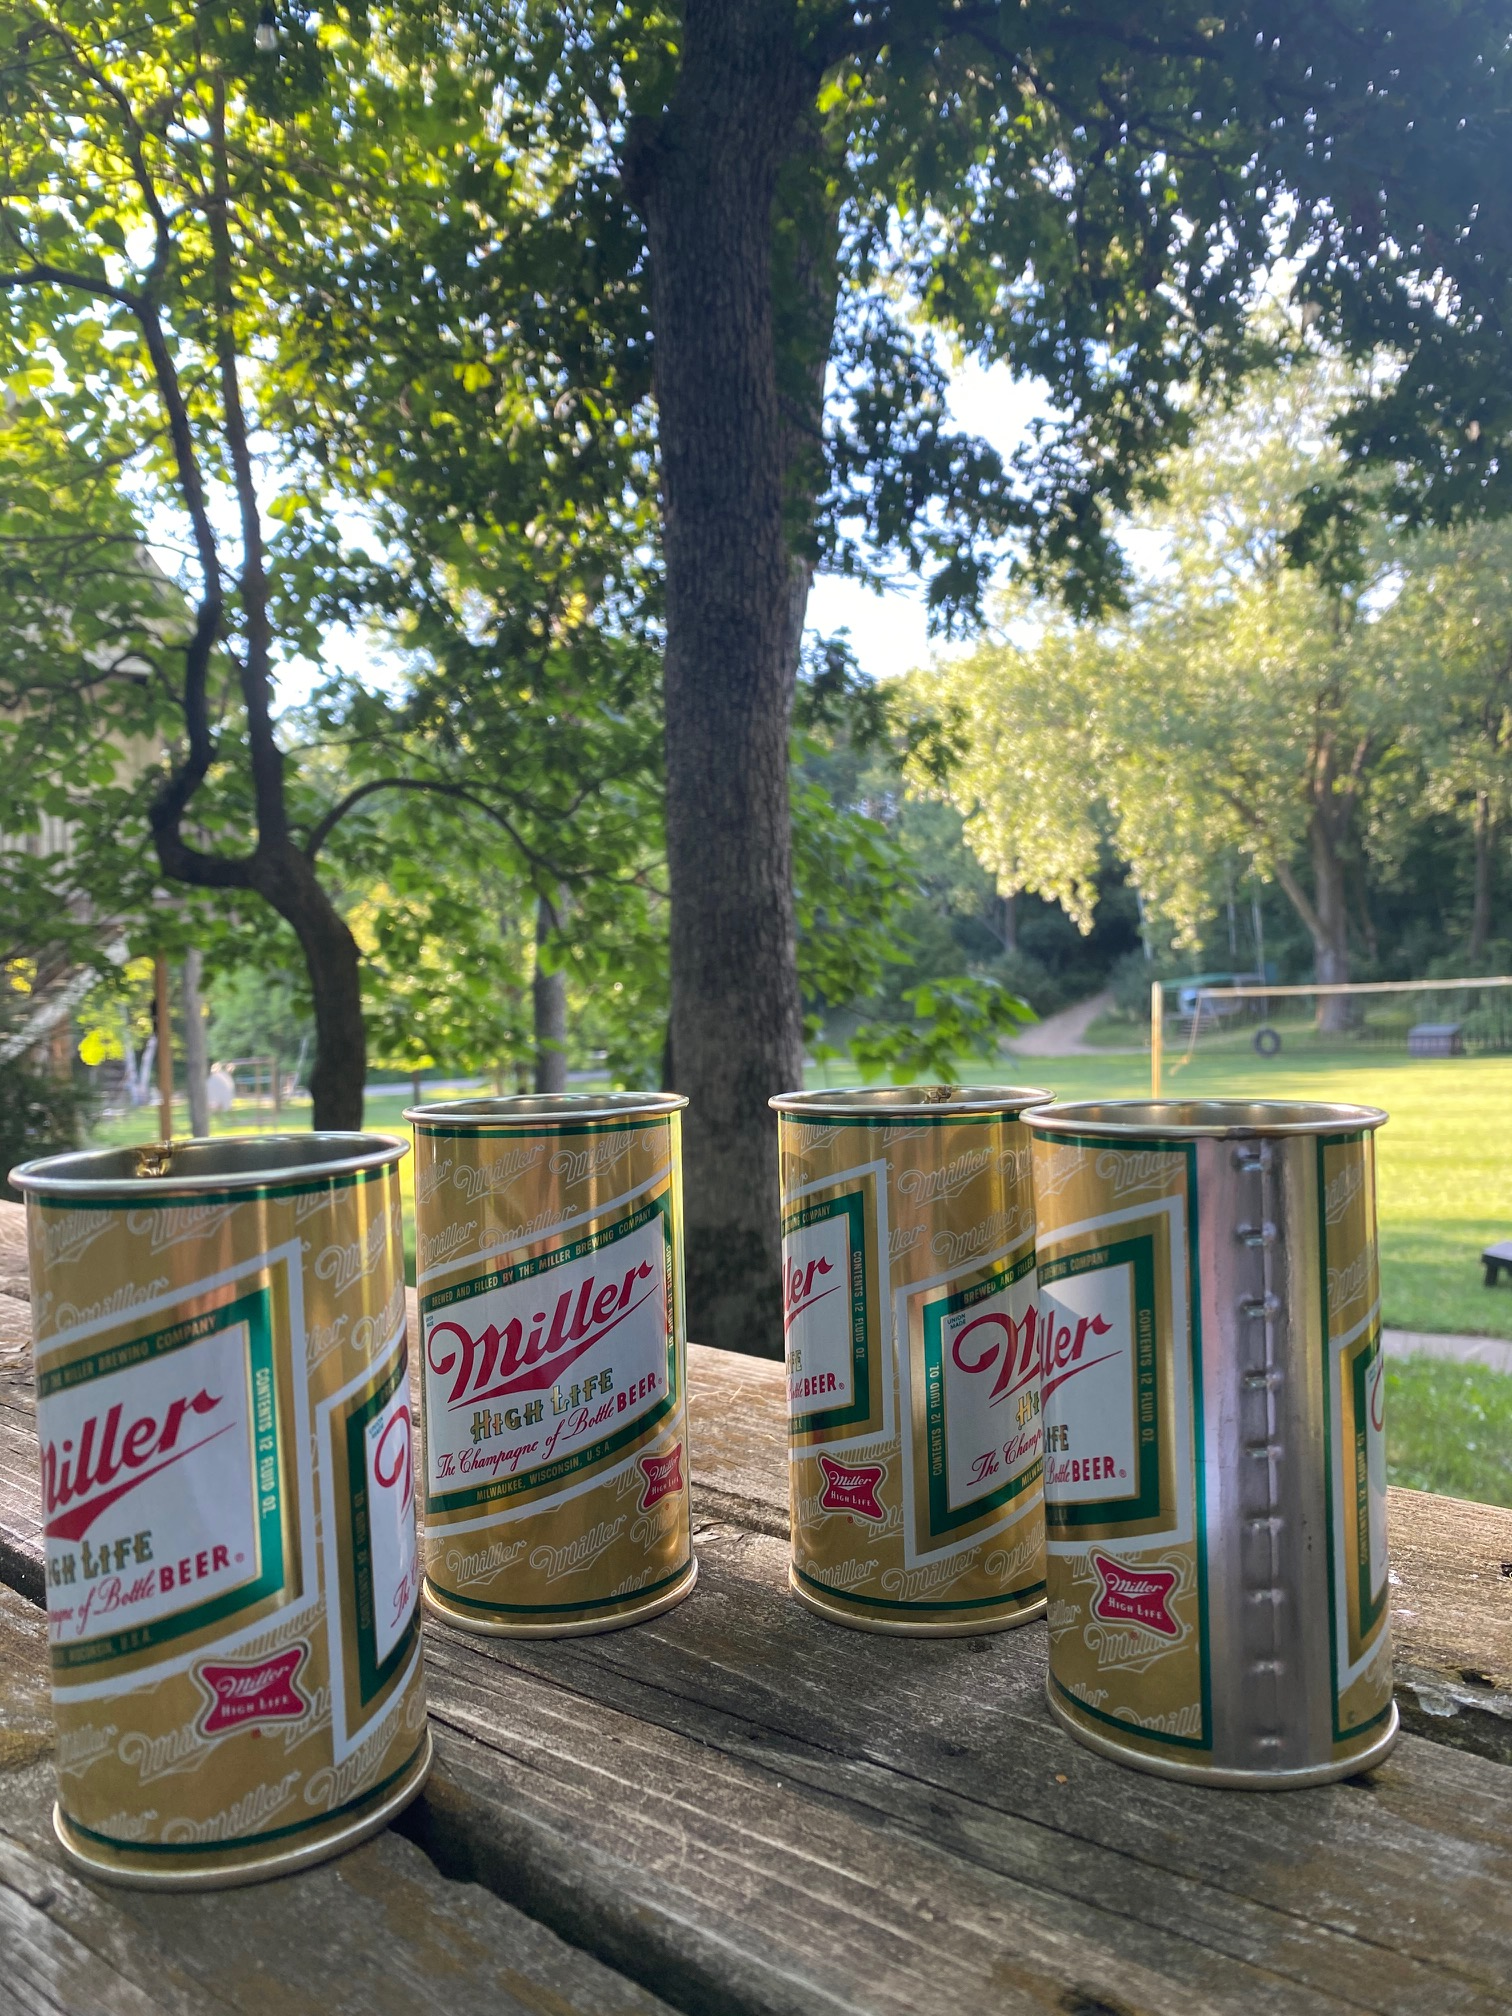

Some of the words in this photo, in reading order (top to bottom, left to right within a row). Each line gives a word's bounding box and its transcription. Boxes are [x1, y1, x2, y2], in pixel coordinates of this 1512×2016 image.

[453, 1144, 544, 1200] Miller
[549, 1130, 638, 1185] Miller
[897, 1146, 994, 1204] Miller
[802, 1205, 831, 1223] COMPANY
[930, 1206, 1019, 1265] Miller
[420, 1220, 477, 1267] Miller
[431, 1291, 453, 1307] BREWED
[456, 1285, 471, 1299] AND
[474, 1276, 498, 1292] FILLED
[502, 1270, 514, 1283] BY
[519, 1263, 535, 1278] THE
[539, 1250, 571, 1271] MILLER
[576, 1230, 614, 1256] BREWING
[618, 1207, 651, 1236] COMPANY
[1070, 1250, 1109, 1271] COMPANY
[853, 1250, 863, 1297] CONTENTS
[963, 1280, 996, 1304] BREWED
[999, 1270, 1014, 1286] AND
[1017, 1257, 1034, 1276] FILLED
[854, 1300, 864, 1312] 12
[947, 1313, 966, 1325] UNION
[950, 1319, 966, 1330] MADE
[98, 1342, 149, 1371] BREWING
[155, 1315, 216, 1350] COMPANY
[428, 1259, 656, 1405] Miller
[855, 1317, 864, 1343] FLUID
[1138, 1309, 1152, 1368] CONTENTS
[929, 1361, 940, 1379] OZ.
[1139, 1371, 1152, 1387] 12
[255, 1367, 272, 1432] CONTENTS
[470, 1399, 543, 1445] HIGH
[552, 1367, 614, 1417] LIFE
[929, 1384, 940, 1410] FLUID
[930, 1412, 941, 1425] 12
[1140, 1391, 1152, 1422] FLUID
[41, 1388, 228, 1522] iller
[259, 1436, 273, 1452] 12
[436, 1453, 456, 1479] The
[457, 1440, 538, 1476] Champagne
[541, 1424, 563, 1459] of
[562, 1398, 614, 1440] Bottle
[932, 1427, 942, 1476] CONTENTS
[967, 1449, 999, 1486] The
[1004, 1430, 1043, 1465] Champ
[260, 1456, 276, 1492] FLUID
[476, 1478, 526, 1501] MILWAUKEE,
[529, 1457, 583, 1485] WISCONSIN,
[829, 1471, 872, 1487] Miller
[1046, 1456, 1070, 1484] Bottle
[831, 1490, 850, 1504] HIGH
[852, 1495, 871, 1507] LIFE
[81, 1530, 154, 1579] LIFE
[446, 1540, 527, 1583] Miller
[529, 1514, 627, 1579] Miller
[94, 1569, 155, 1615] Bottle
[806, 1558, 879, 1588] Miller
[882, 1547, 982, 1601] Miller
[1106, 1573, 1163, 1594] Miller
[1108, 1597, 1134, 1614] HIGH
[1137, 1605, 1163, 1620] LIFE
[217, 1665, 293, 1699] Miller
[221, 1702, 255, 1719] HIGH
[259, 1695, 290, 1716] LIFE
